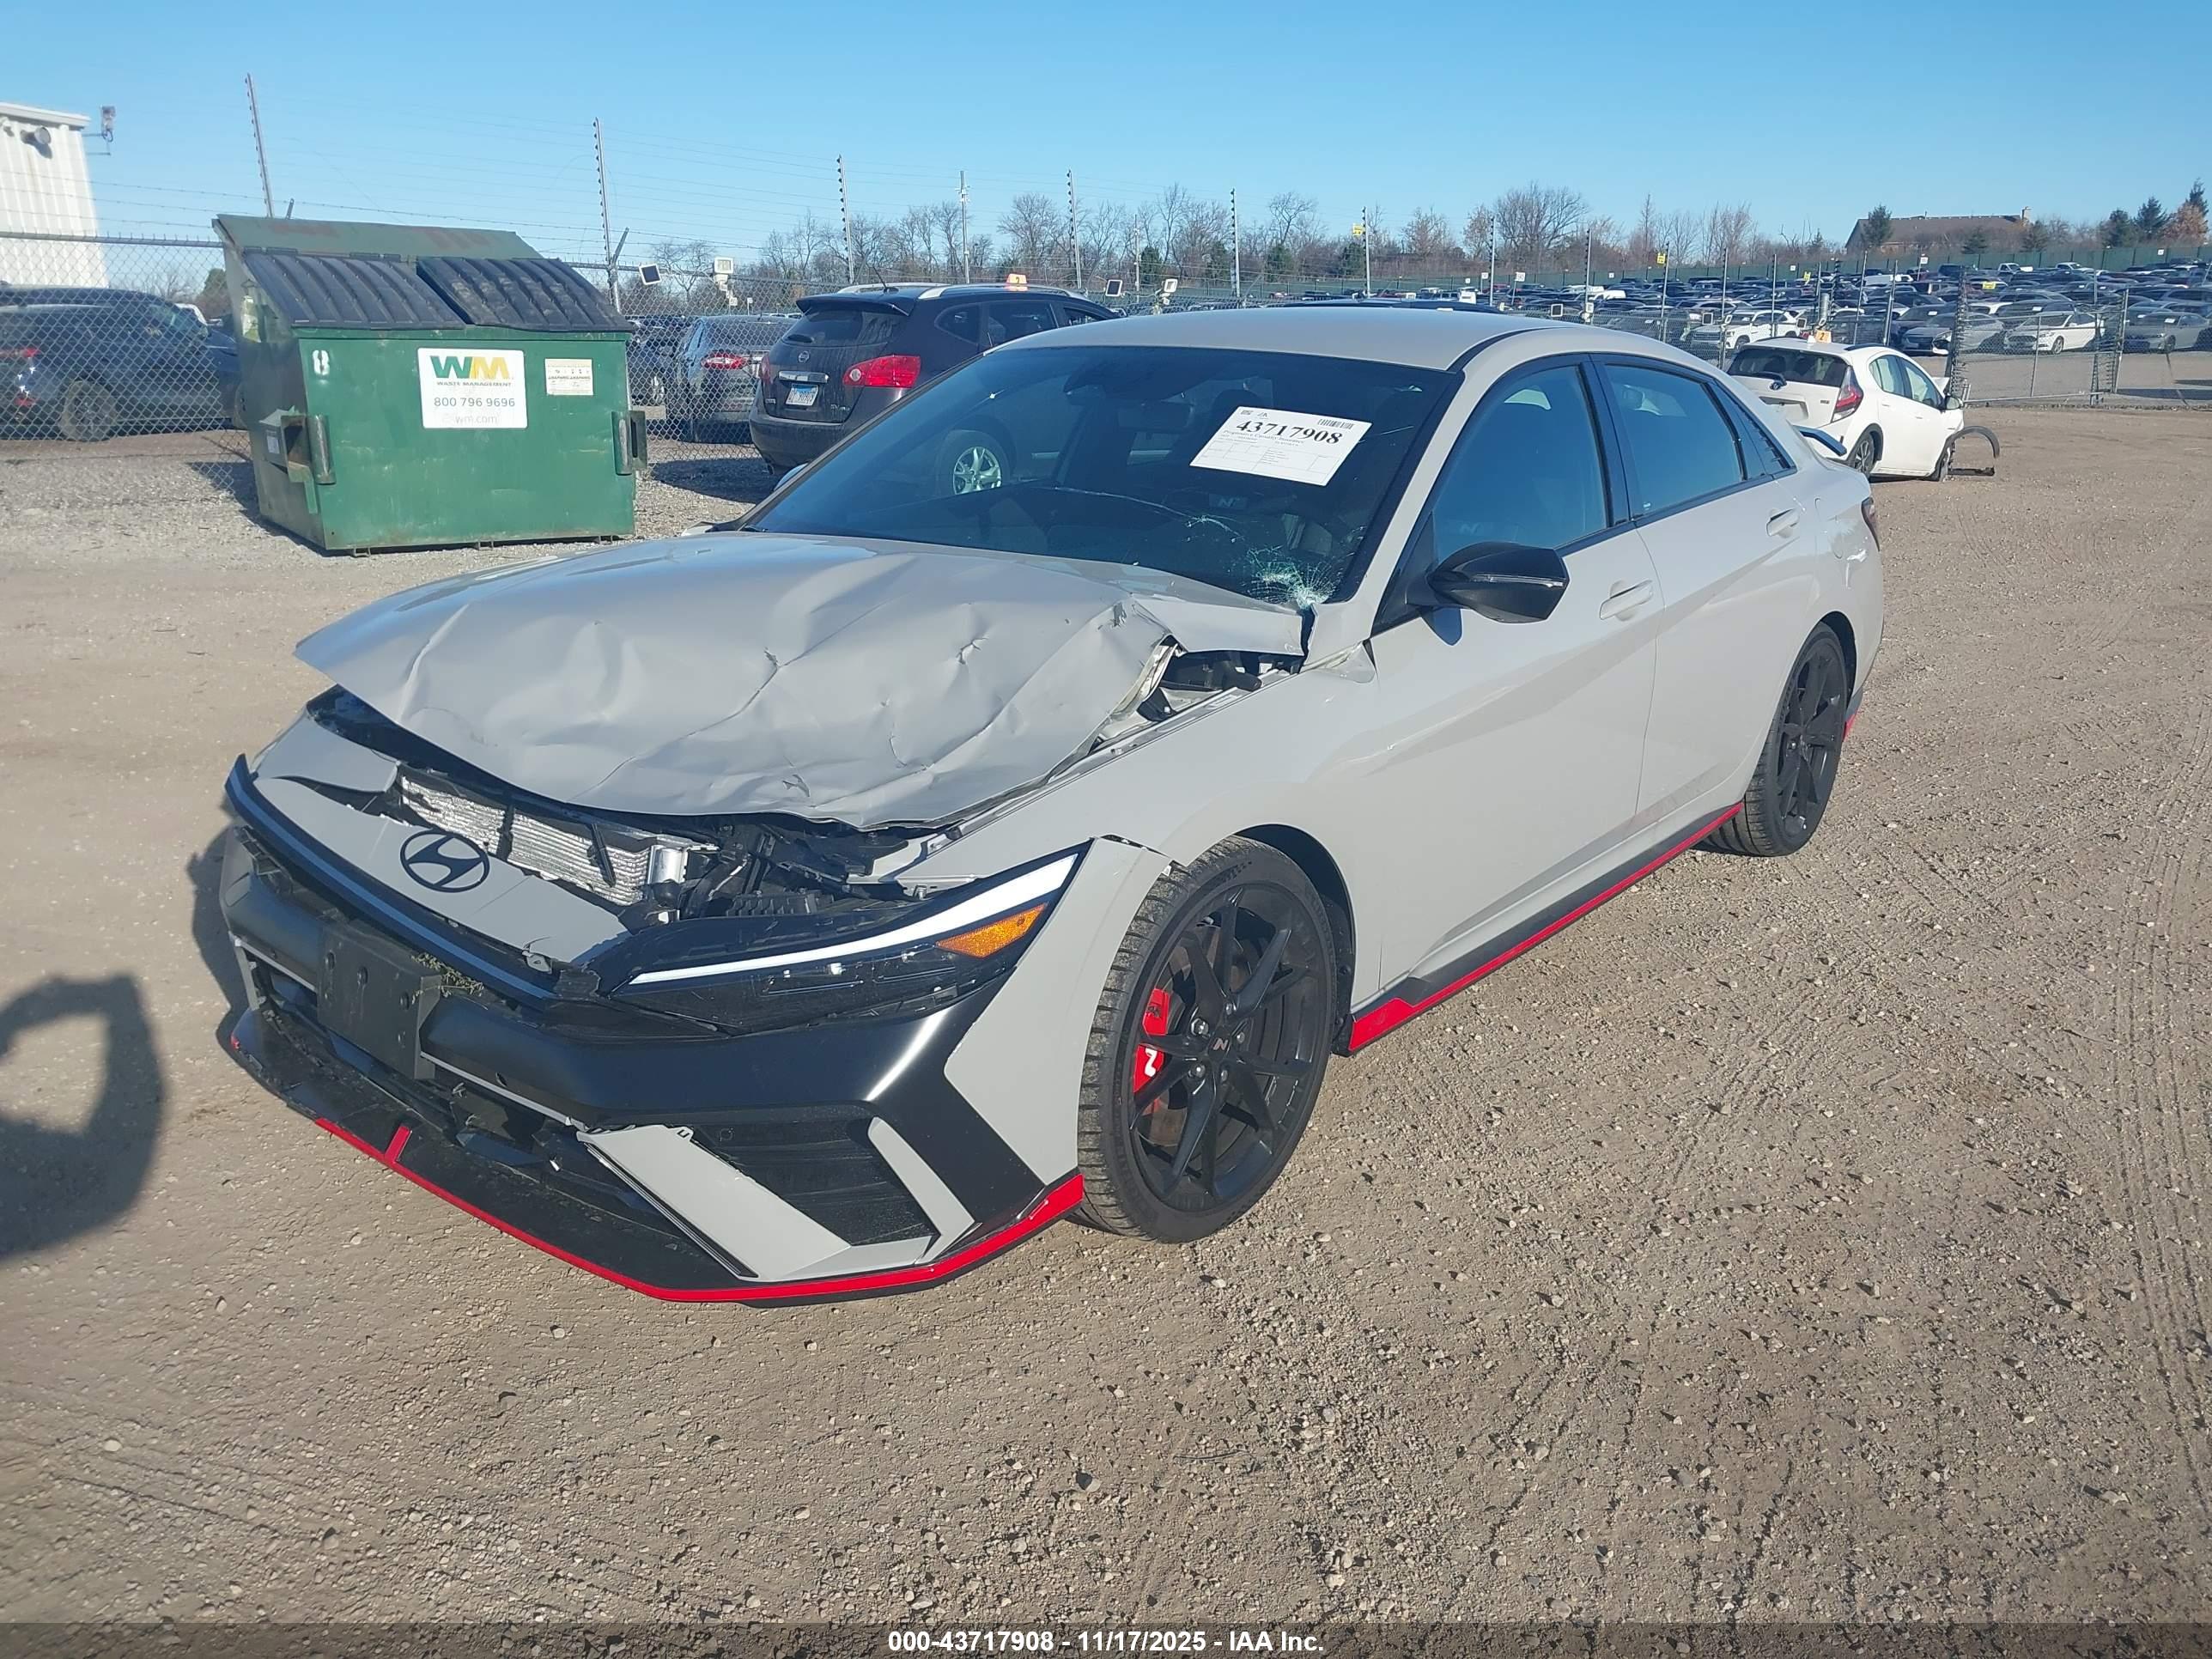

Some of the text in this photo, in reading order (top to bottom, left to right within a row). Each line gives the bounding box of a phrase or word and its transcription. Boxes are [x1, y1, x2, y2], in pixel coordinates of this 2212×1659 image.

[430, 356, 509, 380] WM
[434, 397, 515, 407] 800 796 9696
[455, 415, 498, 424] wm.com
[1237, 420, 1343, 444] 43717908
